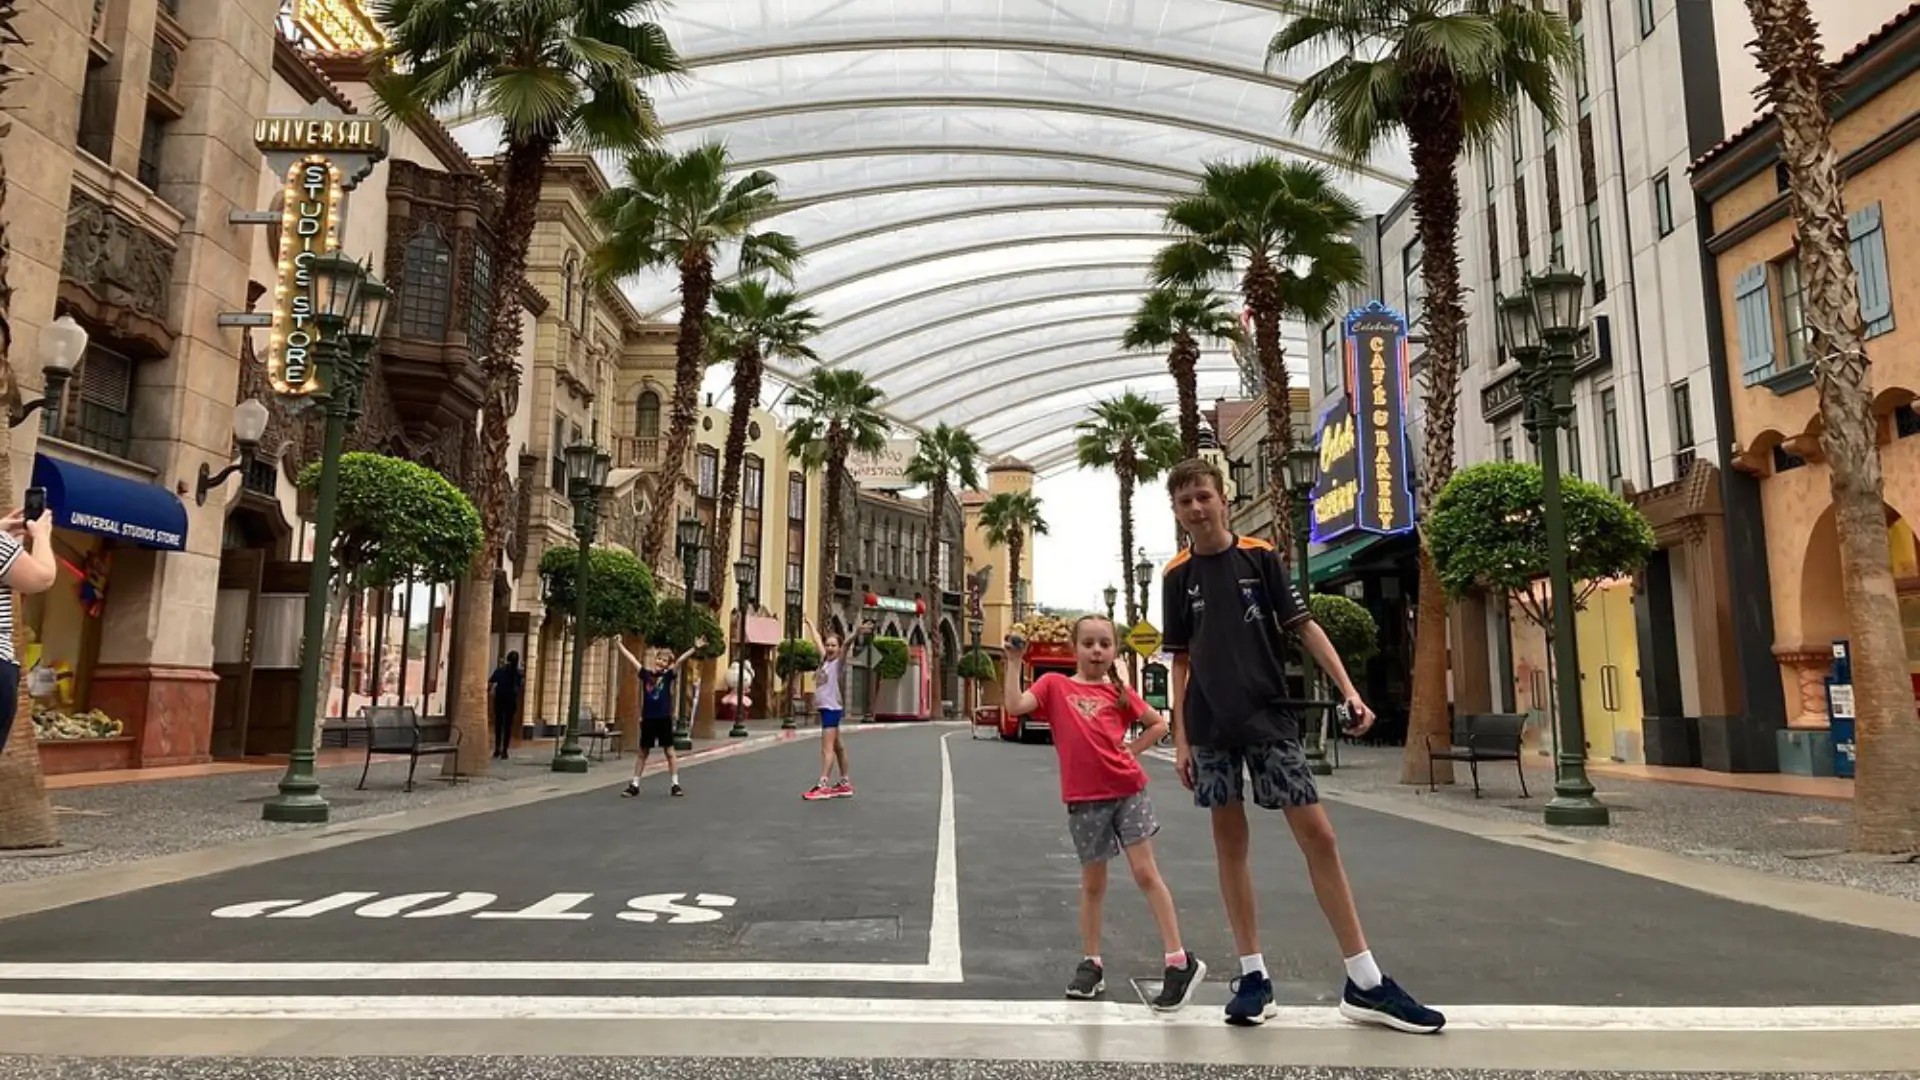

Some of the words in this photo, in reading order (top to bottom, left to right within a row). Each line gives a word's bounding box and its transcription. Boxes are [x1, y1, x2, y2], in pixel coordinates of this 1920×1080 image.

[255, 119, 373, 145] UNIVERSAL
[285, 296, 311, 382] STORE
[1375, 430, 1394, 530] BAKERY
[70, 511, 119, 534] UNIVERSAL
[121, 522, 155, 541] STUDIOS
[157, 530, 181, 546] STORE
[210, 891, 737, 923] STOP
